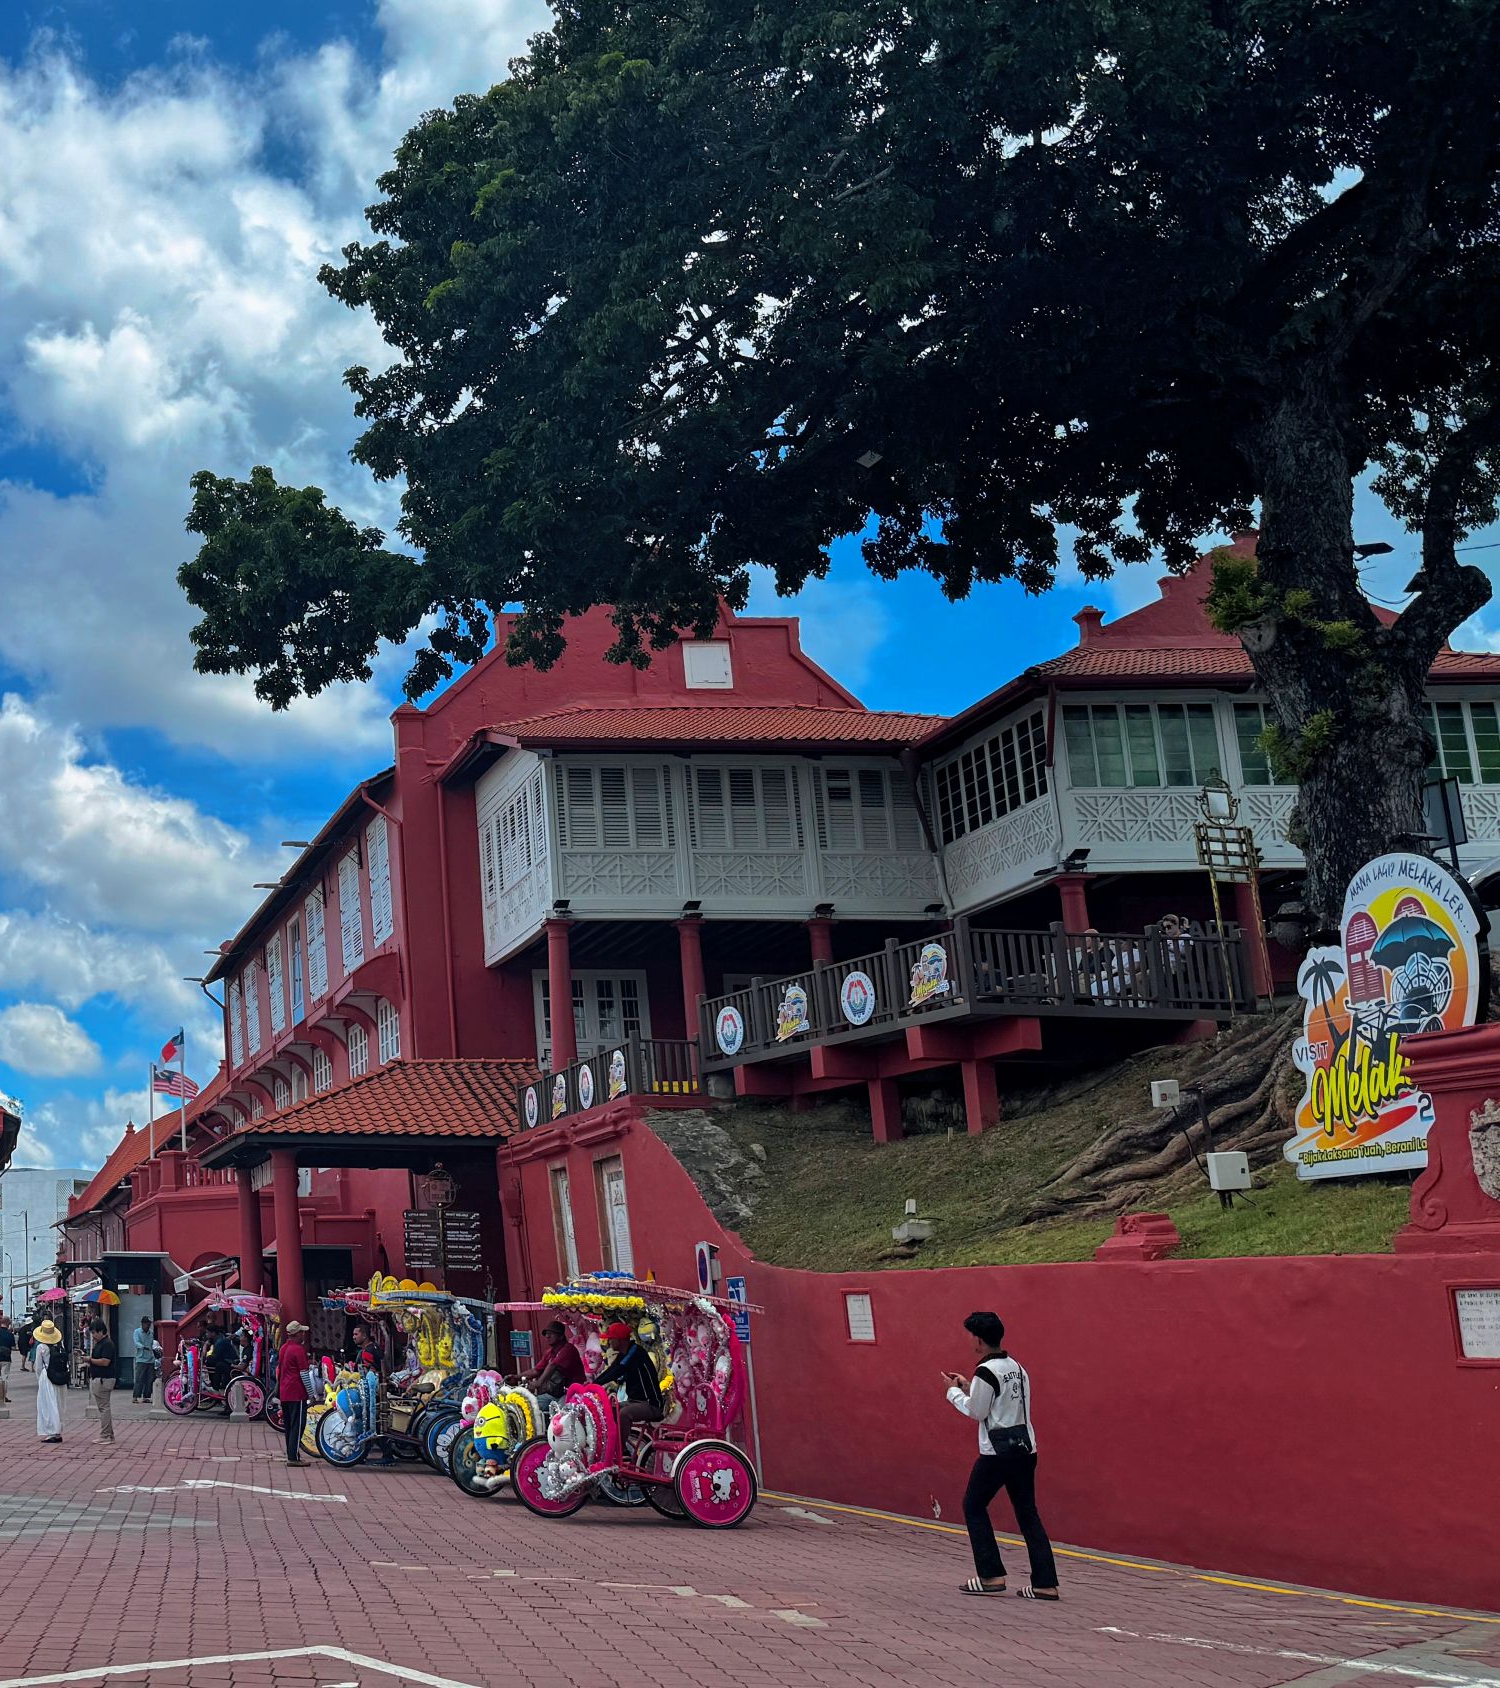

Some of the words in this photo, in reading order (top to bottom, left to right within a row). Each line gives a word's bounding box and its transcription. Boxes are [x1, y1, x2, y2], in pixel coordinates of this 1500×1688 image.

[1349, 872, 1371, 901] MANA
[1372, 863, 1395, 879] LAGI?
[1398, 860, 1442, 896] MELAKA
[1295, 1040, 1328, 1062] VISIT
[1311, 1032, 1414, 1136] Melak
[1323, 1148, 1358, 1162] Laksana
[1358, 1143, 1384, 1159] Tuah,
[1385, 1138, 1416, 1153] Berani
